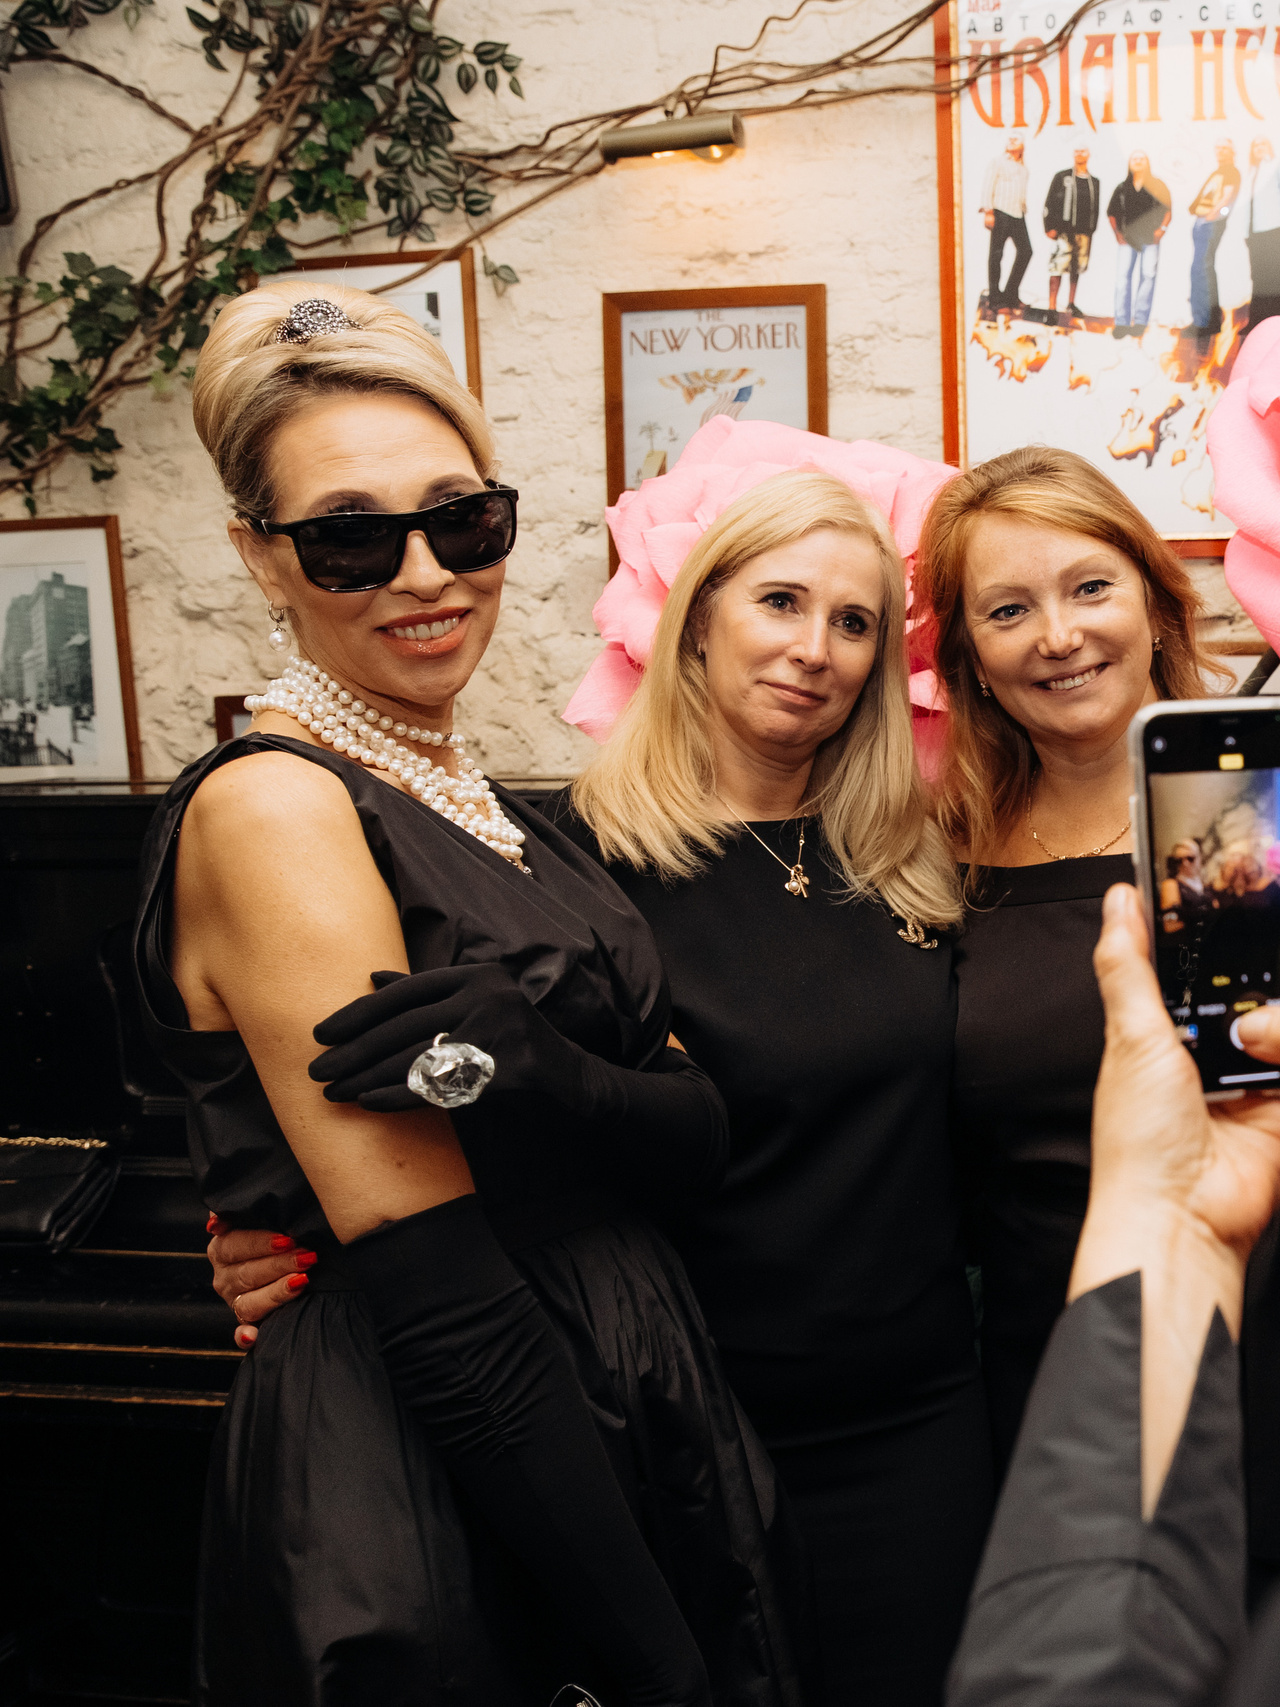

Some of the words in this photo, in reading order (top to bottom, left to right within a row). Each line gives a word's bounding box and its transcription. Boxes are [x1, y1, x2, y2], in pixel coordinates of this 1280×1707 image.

[695, 310, 724, 323] THE
[629, 327, 690, 356] NEW
[696, 322, 801, 353] YORKER
